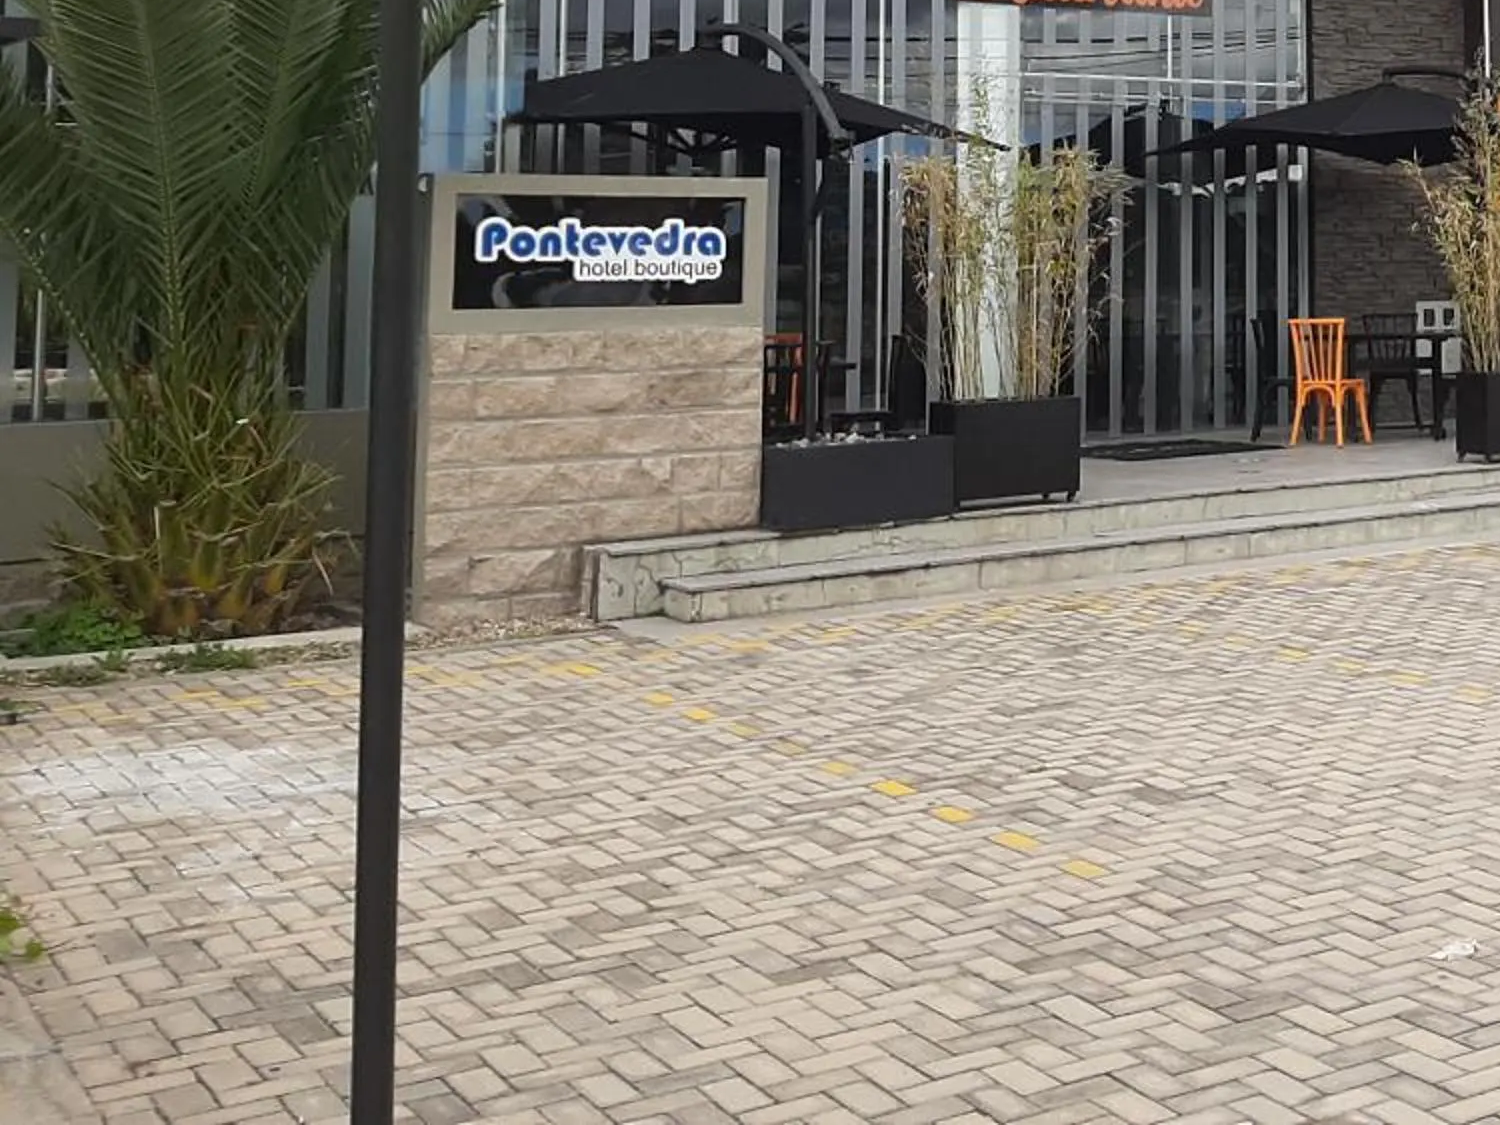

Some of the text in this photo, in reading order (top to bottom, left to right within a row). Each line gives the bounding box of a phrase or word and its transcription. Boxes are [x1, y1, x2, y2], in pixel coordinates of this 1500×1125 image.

[478, 220, 724, 259] Pontevedra
[578, 258, 718, 280] hotel boutique
